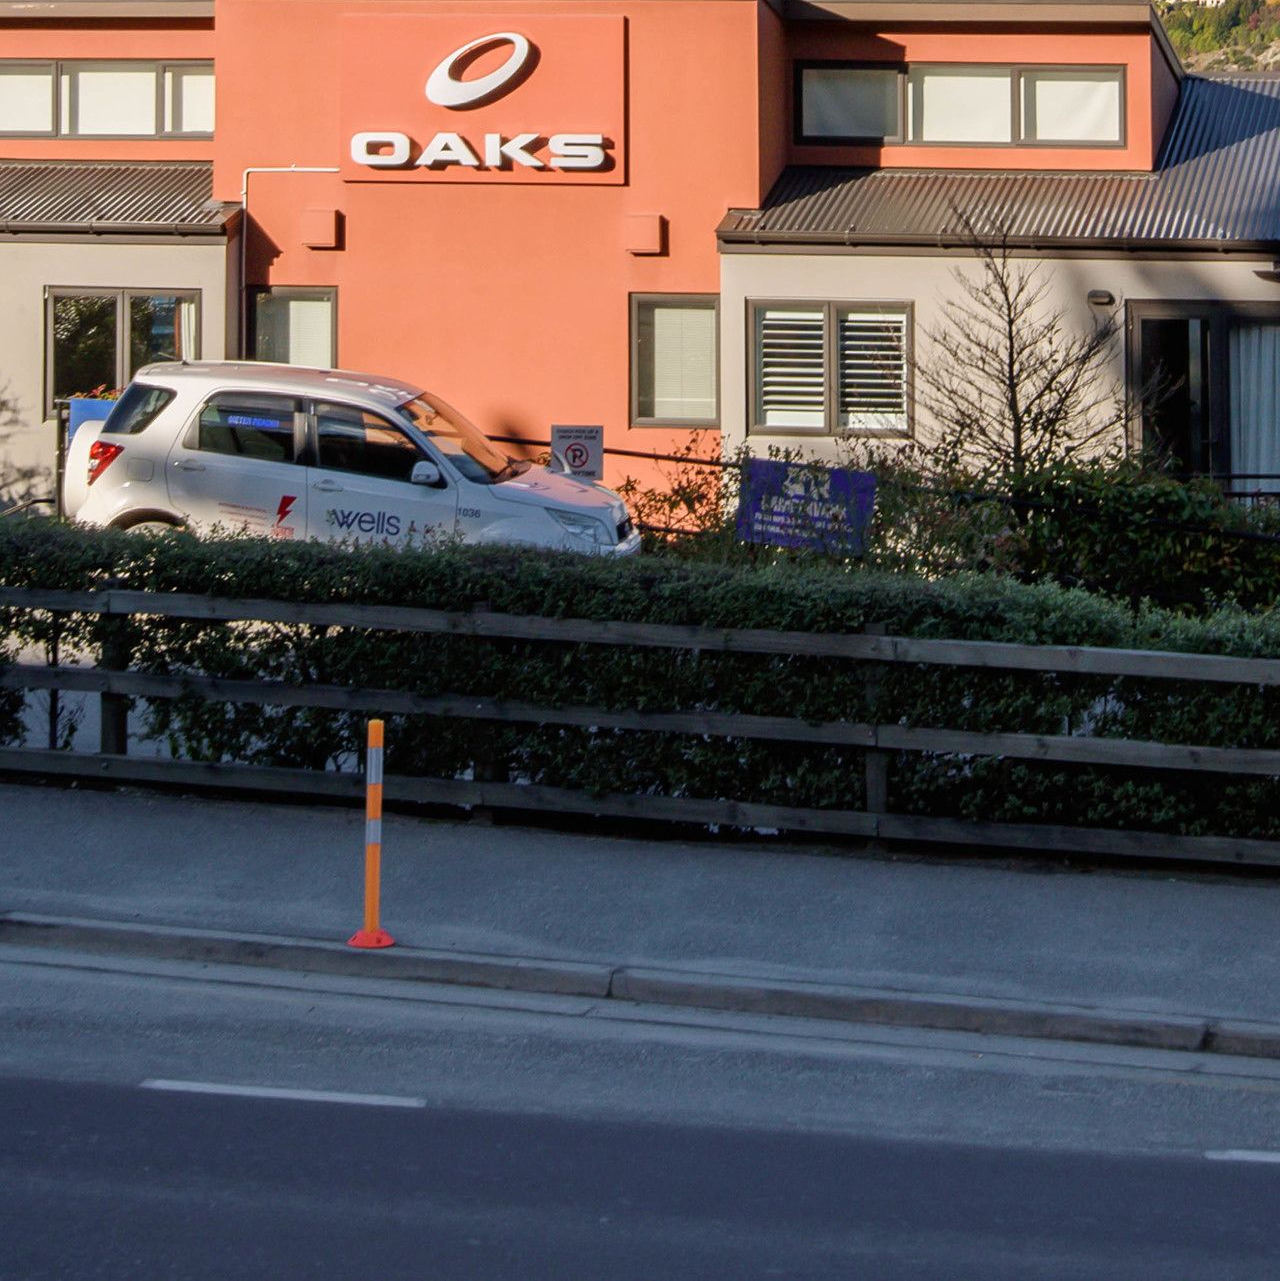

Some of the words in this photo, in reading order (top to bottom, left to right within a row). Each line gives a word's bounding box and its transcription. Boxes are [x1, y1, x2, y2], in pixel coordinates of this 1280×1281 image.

[350, 132, 605, 167] OAKS
[331, 509, 401, 536] wells
[458, 507, 481, 519] 1036
